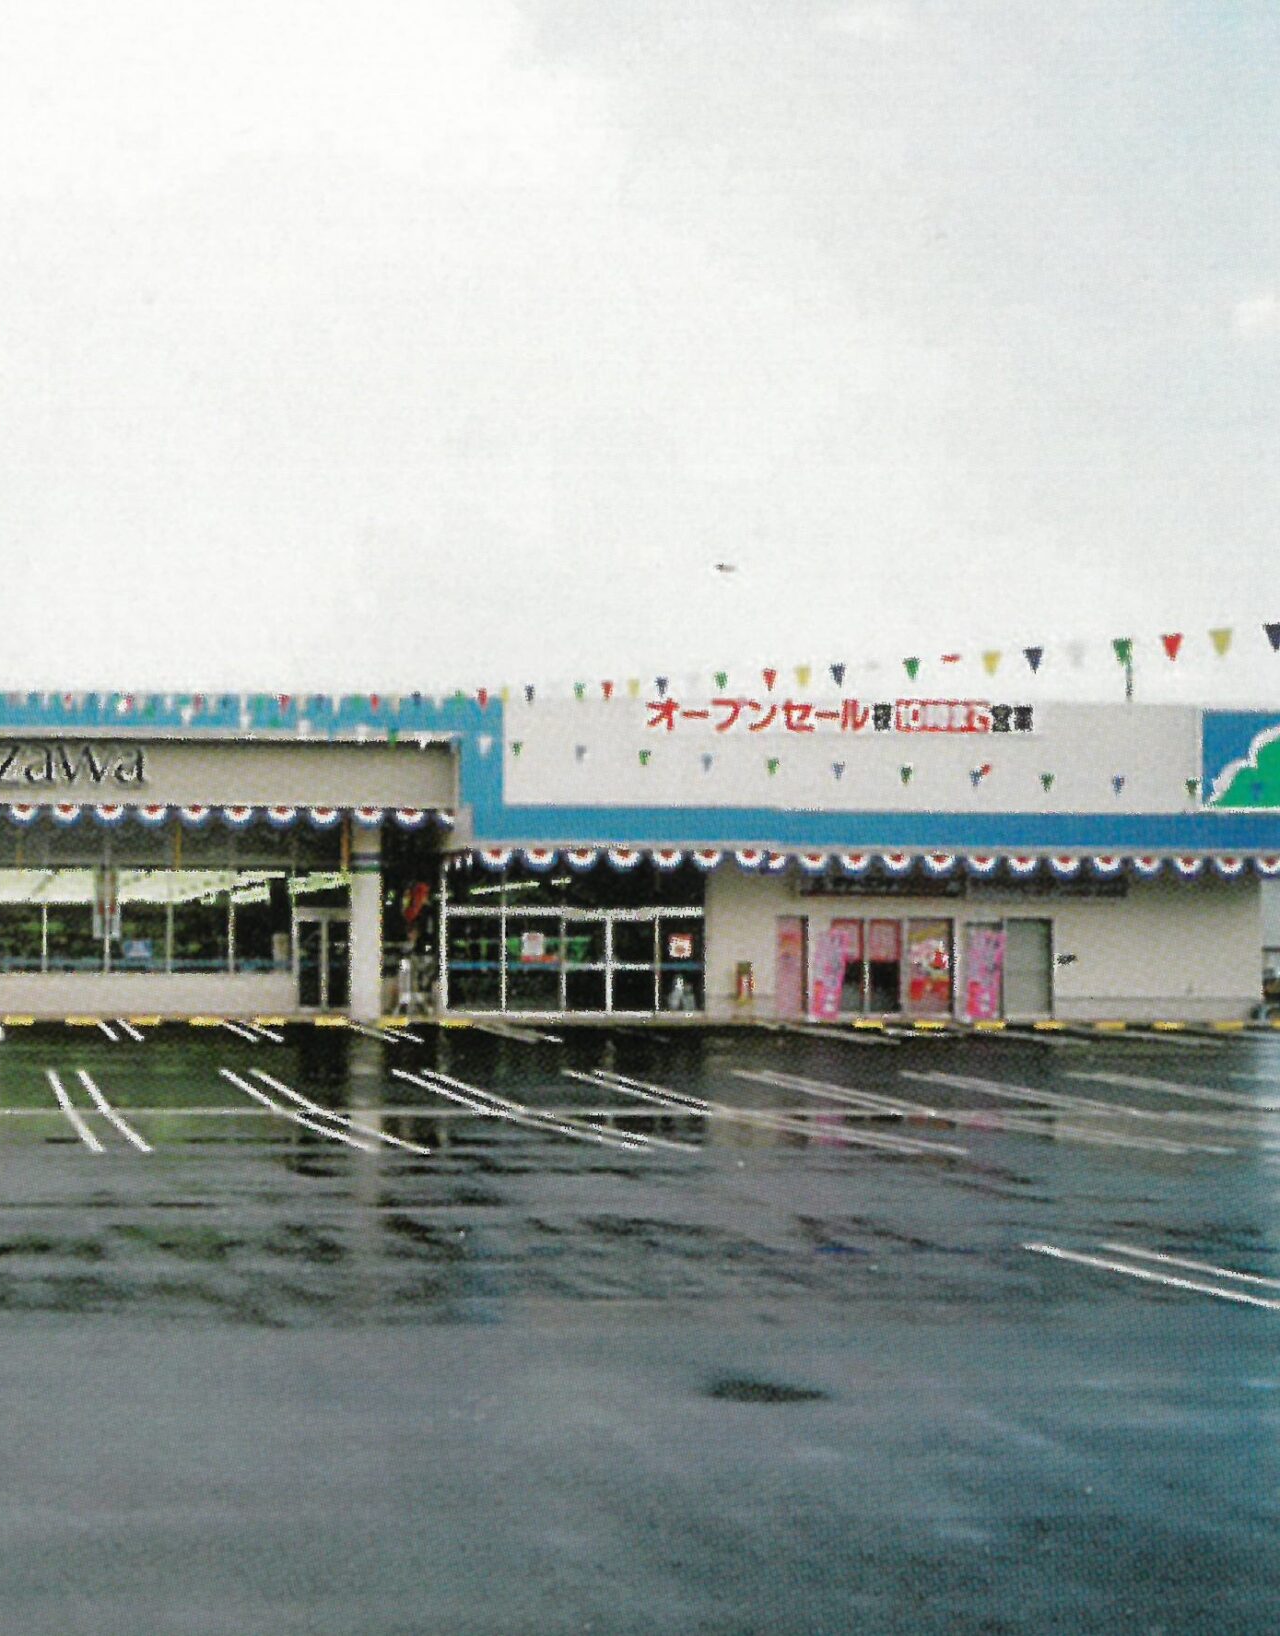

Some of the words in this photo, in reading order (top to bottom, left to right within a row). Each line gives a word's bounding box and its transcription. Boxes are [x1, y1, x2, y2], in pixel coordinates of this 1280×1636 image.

[646, 698, 869, 733] オープンセール
